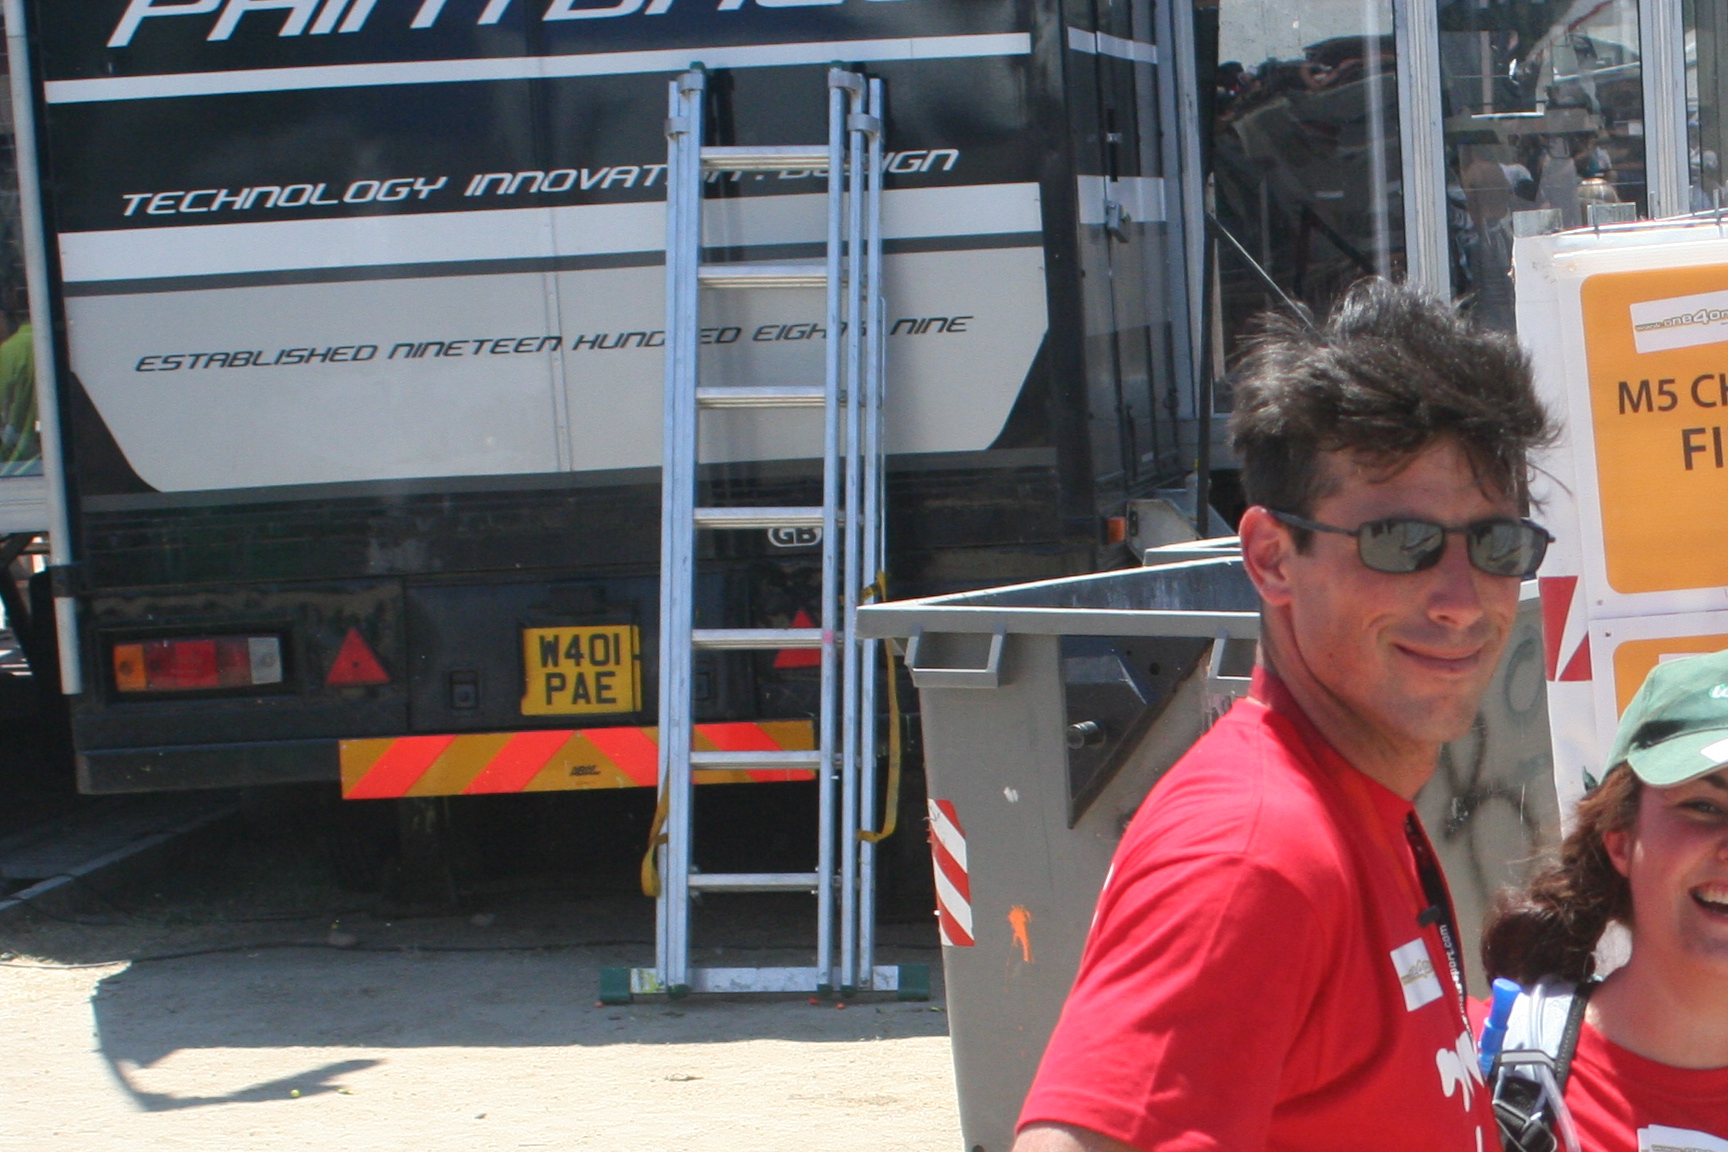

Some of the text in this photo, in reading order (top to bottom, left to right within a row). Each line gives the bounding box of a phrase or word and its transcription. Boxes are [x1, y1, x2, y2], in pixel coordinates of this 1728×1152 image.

[122, 176, 448, 217] TECHNOLOGY
[464, 158, 742, 197] INNOVAT
[135, 344, 379, 373] ESTABLISHED
[387, 335, 563, 360] NINETEEN
[572, 326, 742, 351] HUNED
[890, 315, 974, 335] NINE
[1617, 378, 1679, 415] M5
[538, 632, 620, 668] W401
[545, 670, 616, 705] PAE
